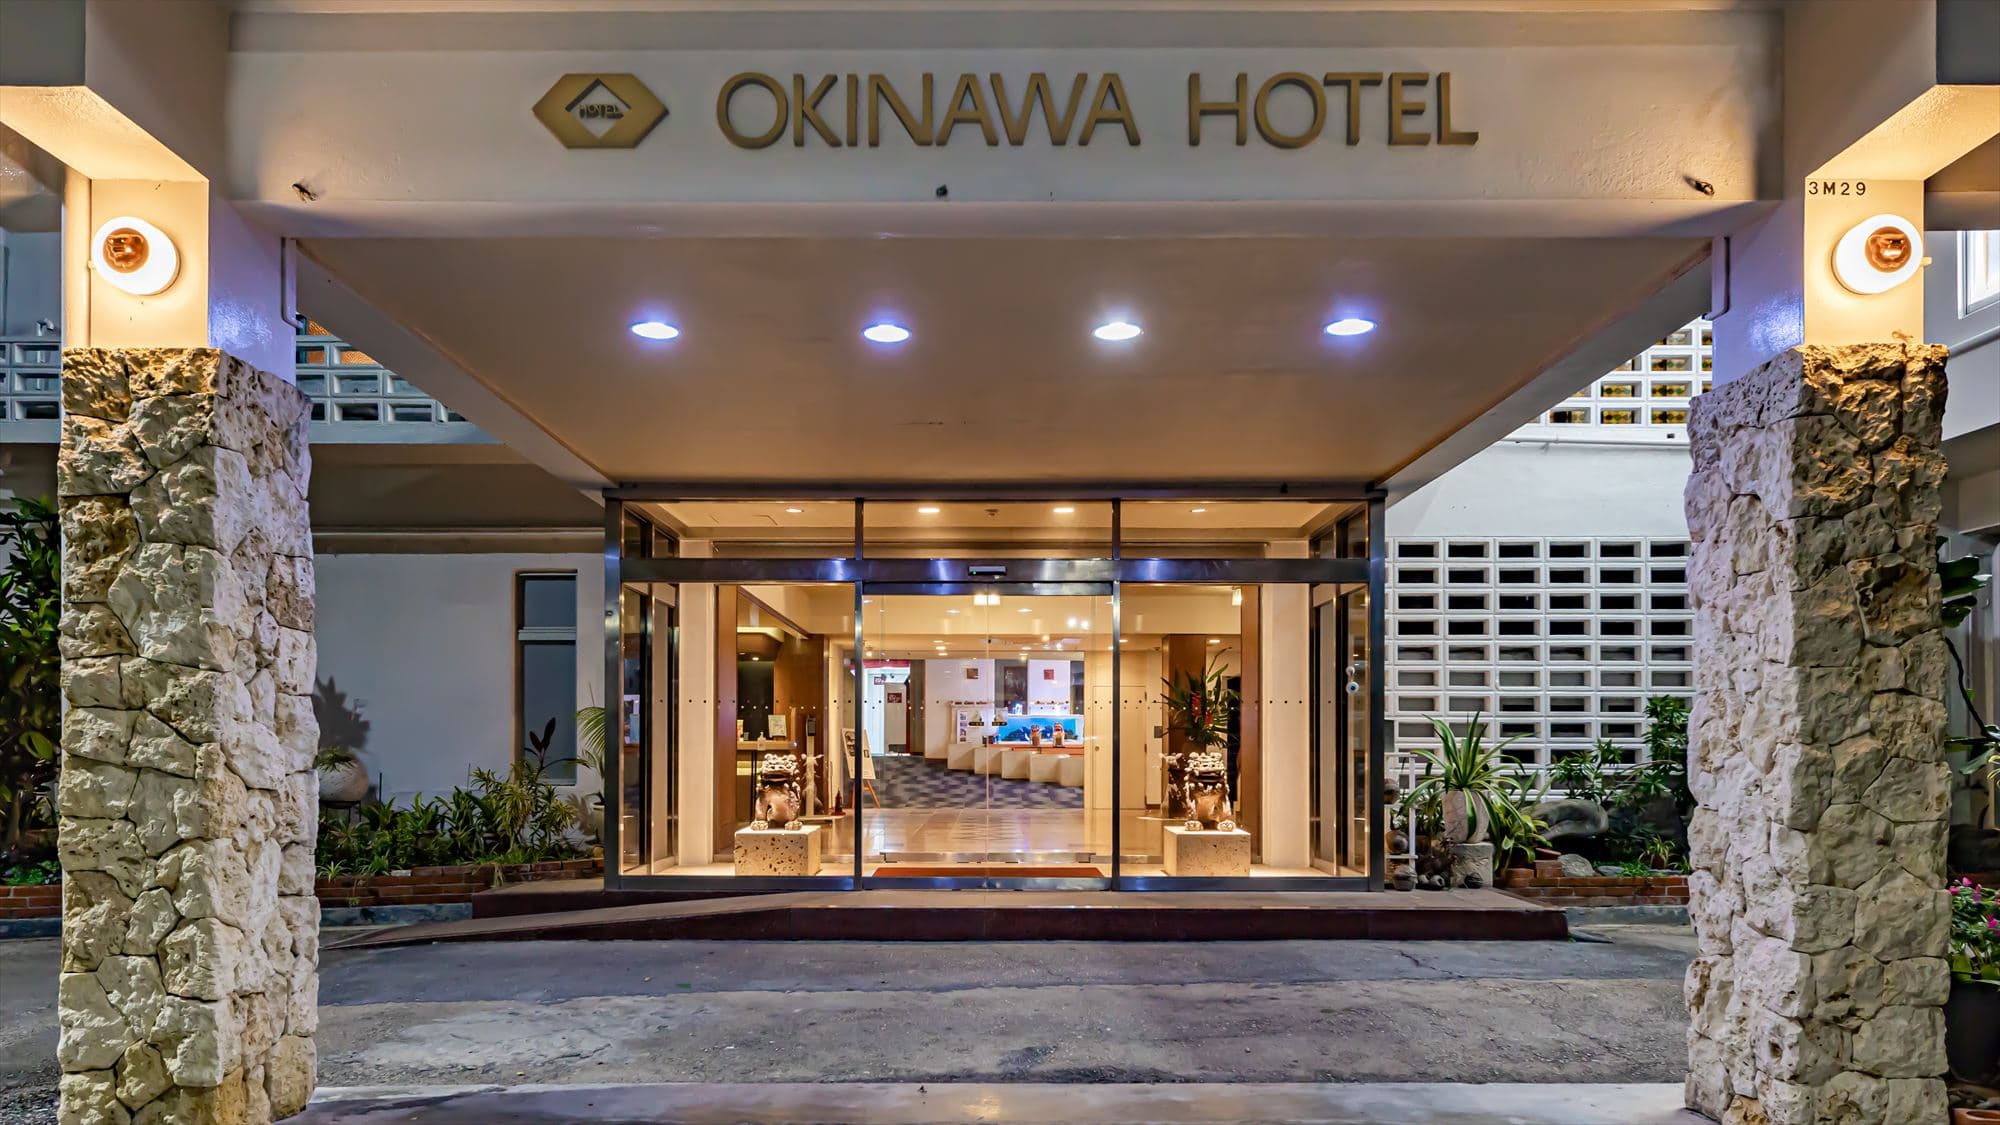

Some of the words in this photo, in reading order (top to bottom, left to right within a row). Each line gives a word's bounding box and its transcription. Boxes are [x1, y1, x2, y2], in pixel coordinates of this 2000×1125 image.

[579, 103, 623, 119] HOTEL
[716, 72, 1141, 149] OKINAWA
[1188, 72, 1479, 149] HOTEL
[1808, 181, 1867, 196] 3M29
